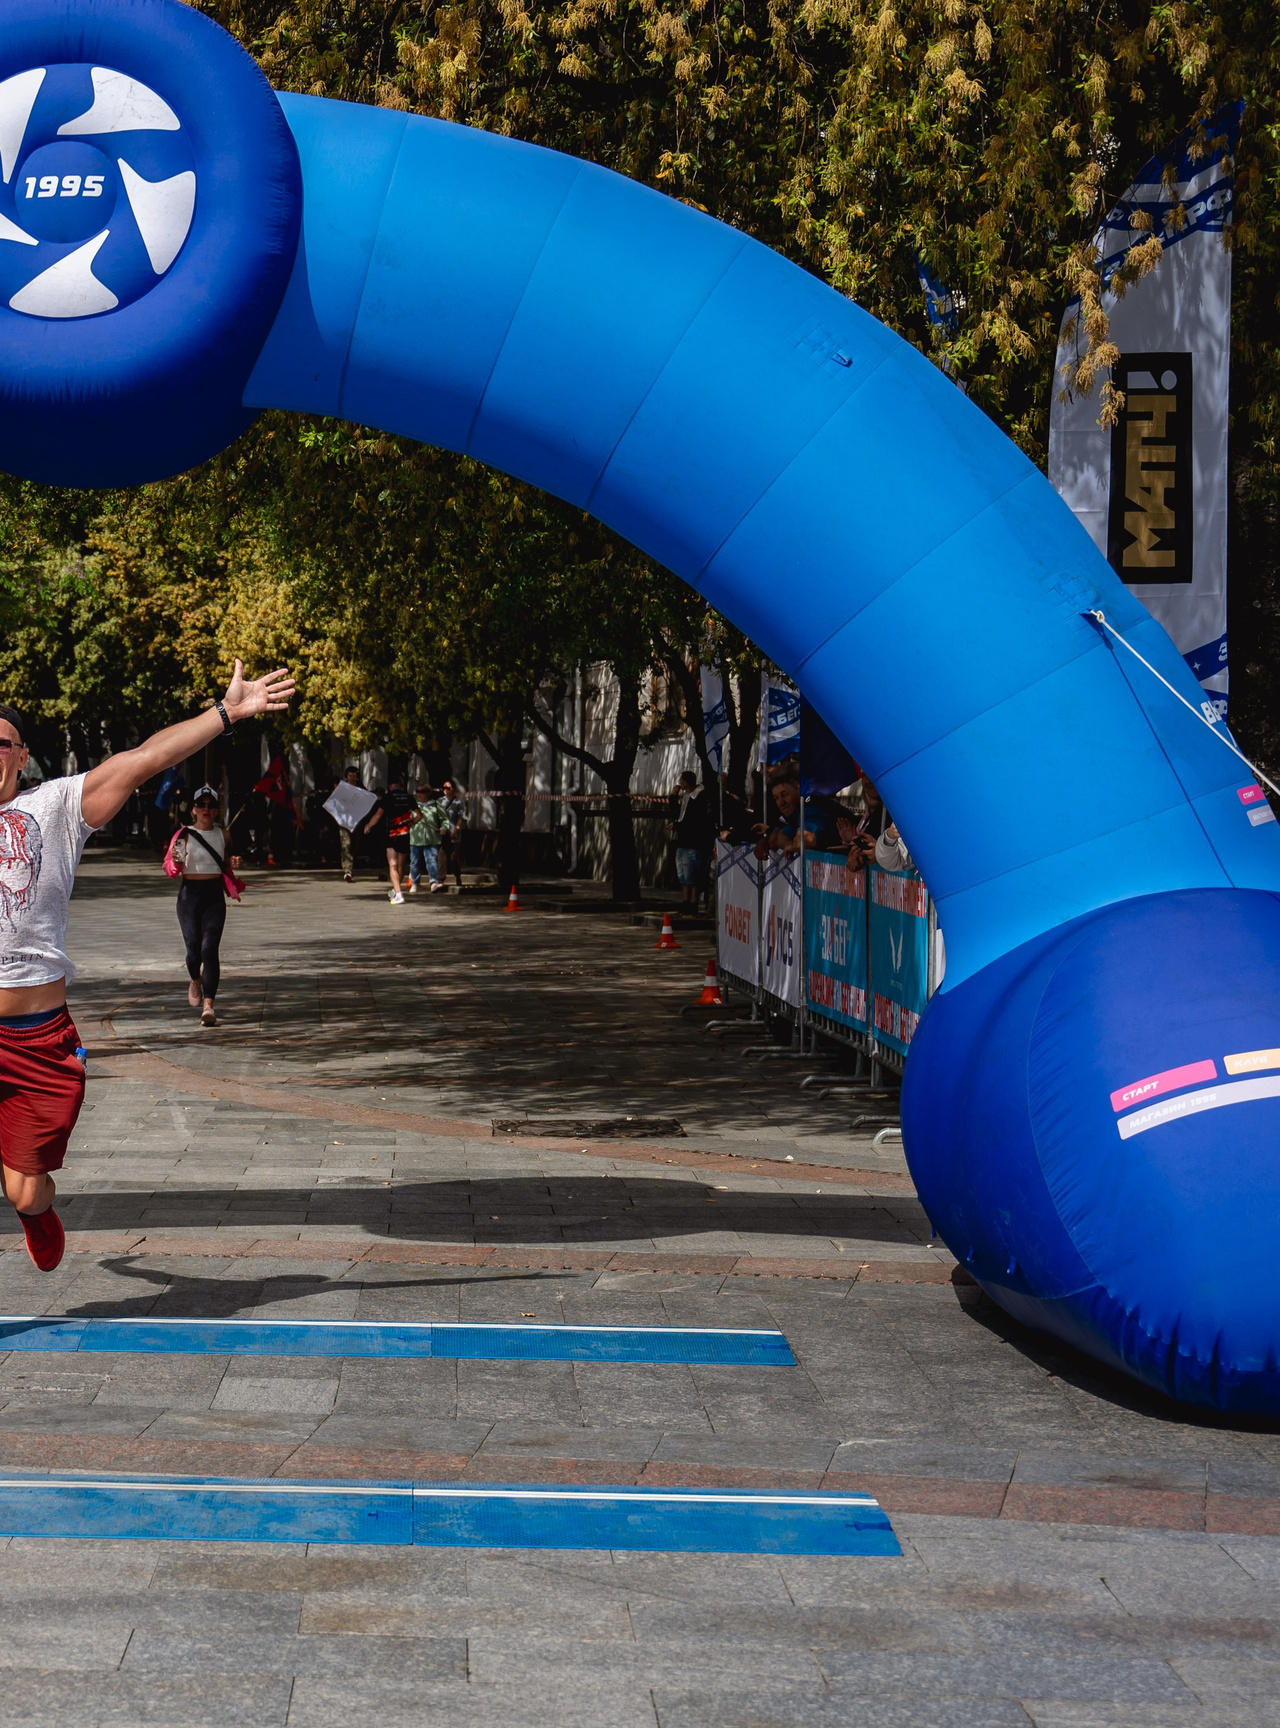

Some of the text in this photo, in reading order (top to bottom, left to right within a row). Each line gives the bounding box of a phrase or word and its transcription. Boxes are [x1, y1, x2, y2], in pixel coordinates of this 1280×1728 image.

[25, 175, 105, 199] 1995
[1122, 370, 1177, 567] МАТЧ!
[724, 903, 752, 945] FONBET
[776, 917, 793, 968] ПСБ
[1, 953, 44, 964] PLEIN
[1234, 1055, 1268, 1068] КЛУБ
[1122, 1081, 1159, 1102] СТАРТ
[1129, 1093, 1217, 1129] МАГАЗИН 1995
